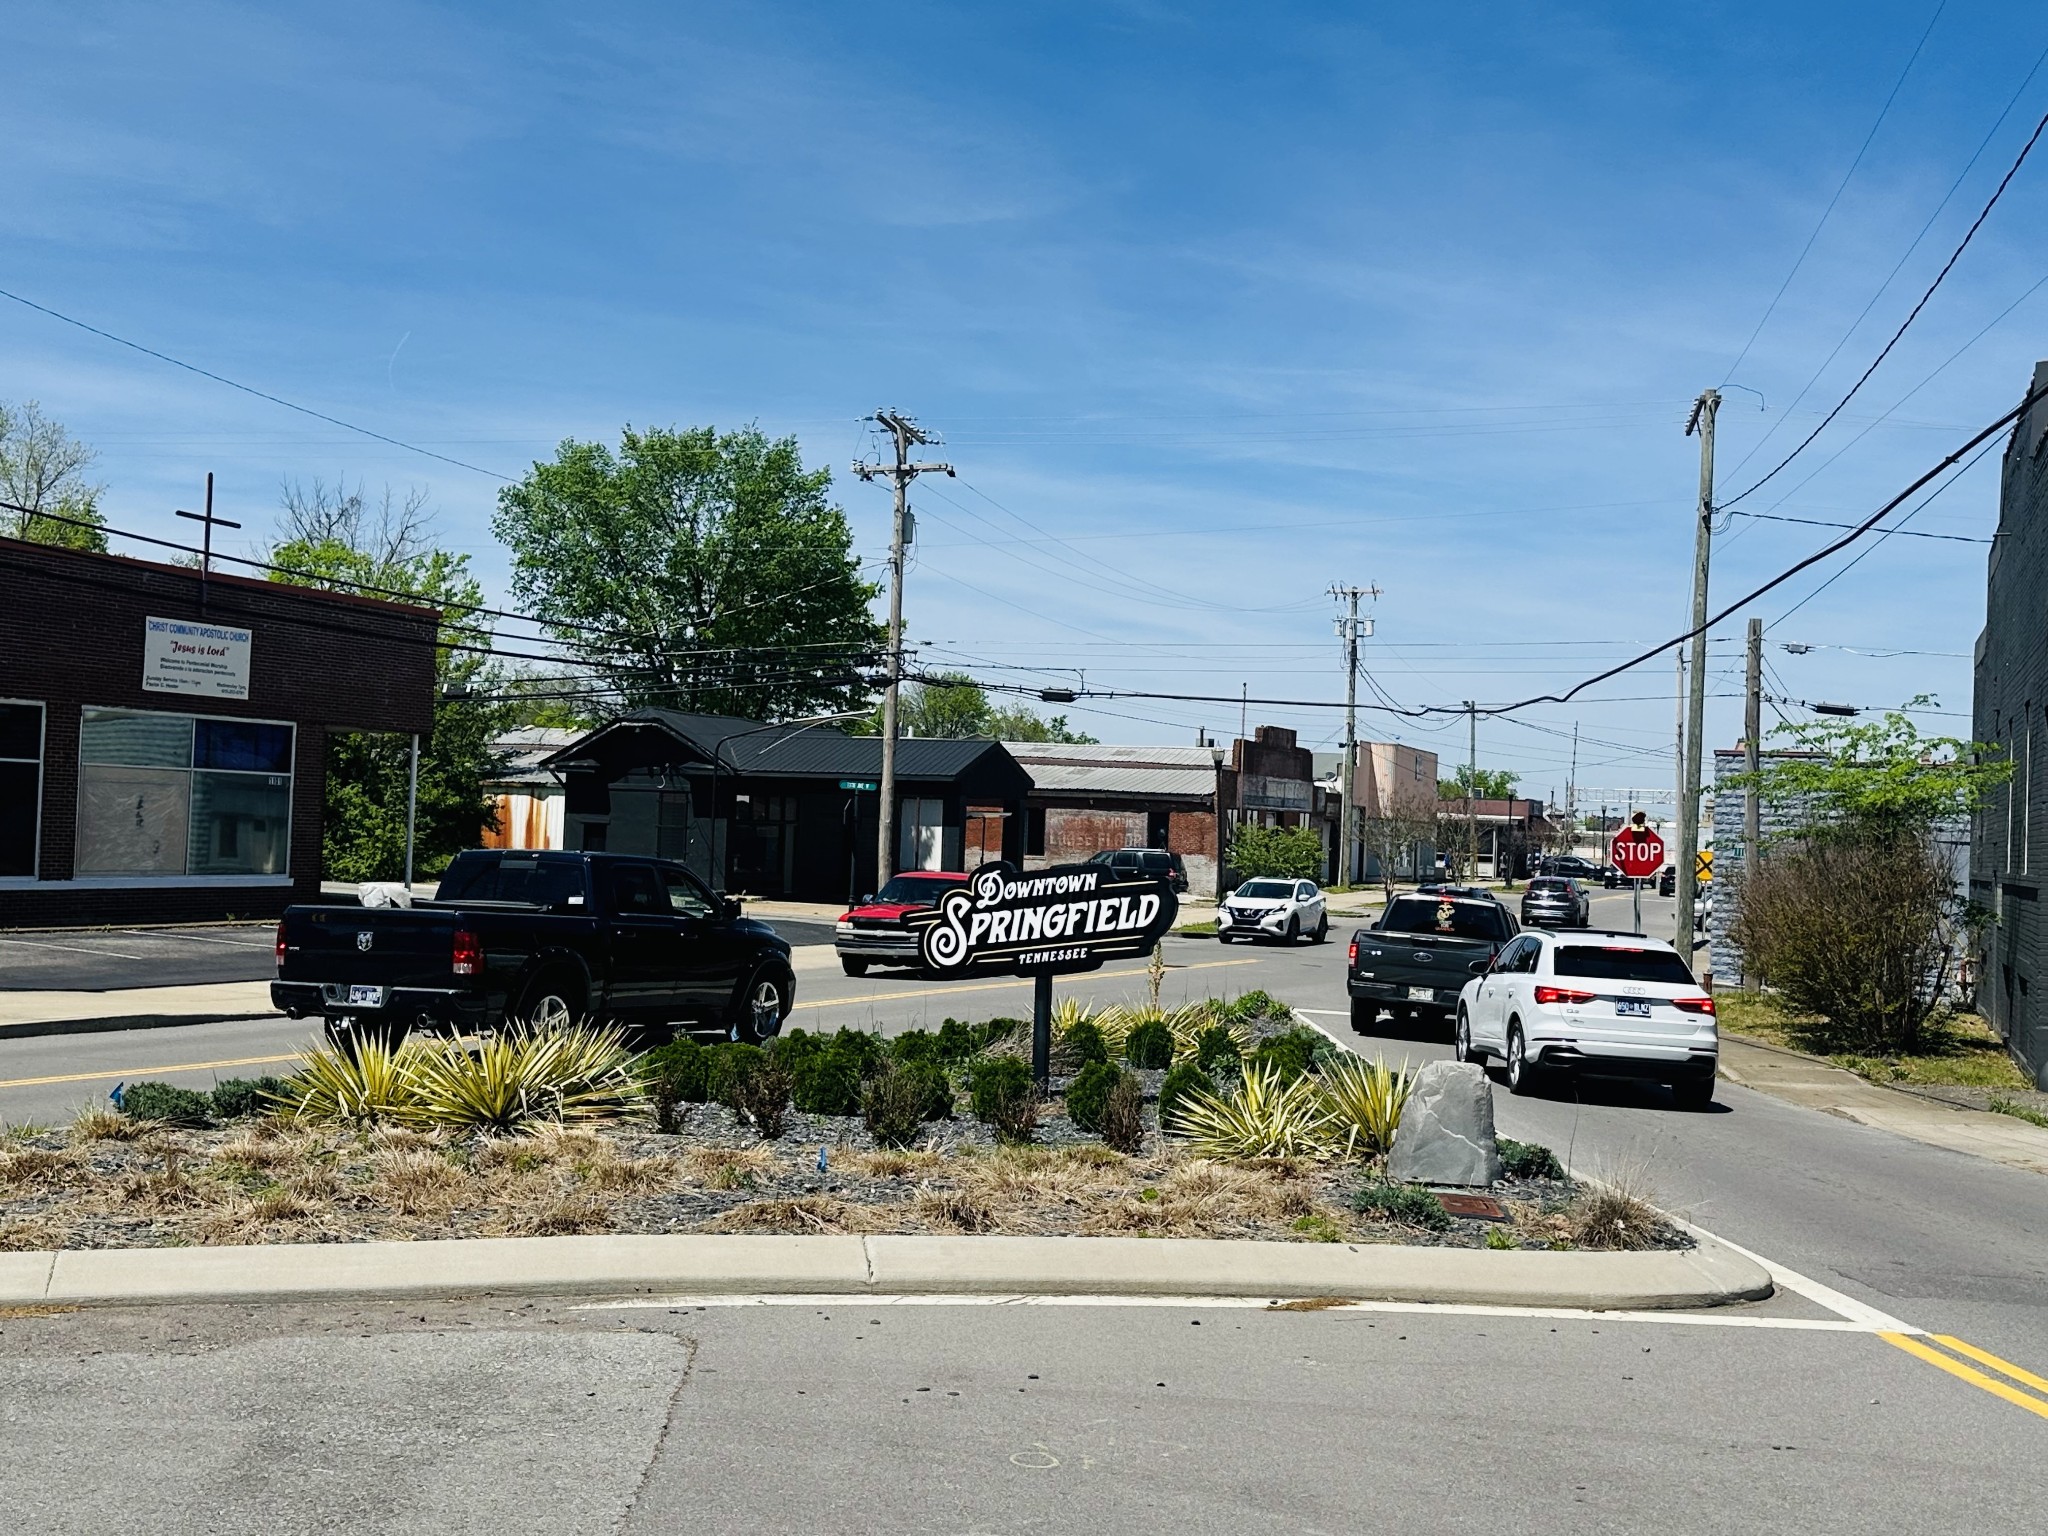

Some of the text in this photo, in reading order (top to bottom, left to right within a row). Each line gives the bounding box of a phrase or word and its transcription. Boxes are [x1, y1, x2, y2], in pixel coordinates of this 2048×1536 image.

[148, 620, 249, 642] CHRIST COMMUNITY APOSTOLIC CHURCH
[198, 644, 206, 655] is
[1615, 842, 1661, 861] STOP
[976, 869, 1098, 909] DOWNTOWN
[931, 894, 1160, 966] SPRINGFIELD
[1018, 947, 1088, 965] TENNESSEE
